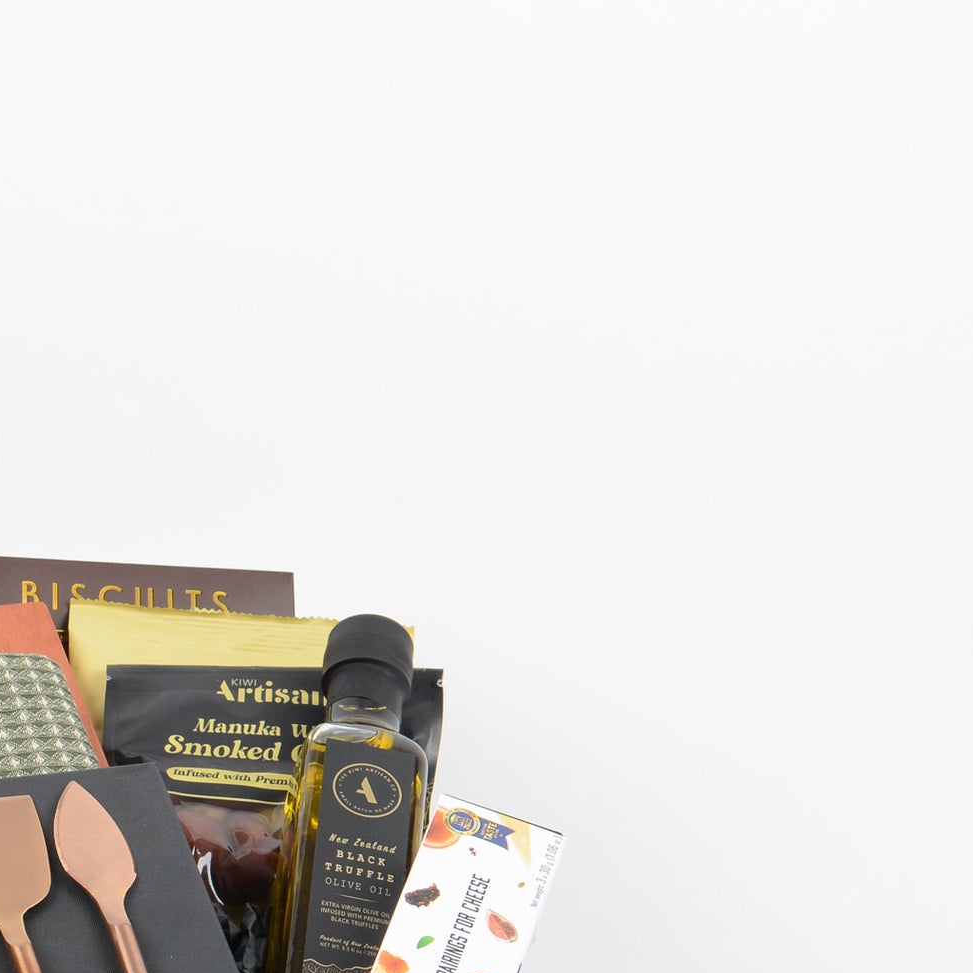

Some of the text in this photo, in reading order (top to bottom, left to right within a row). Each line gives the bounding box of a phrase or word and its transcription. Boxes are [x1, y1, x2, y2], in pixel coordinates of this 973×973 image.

[22, 580, 229, 612] BISCUITS
[216, 680, 327, 706] Artisan
[231, 678, 257, 687] KIWI
[193, 718, 281, 737] Manuka
[164, 734, 282, 762] Smoked
[173, 769, 219, 779] Infused
[223, 773, 251, 782] with
[328, 833, 397, 854] New Zealand
[336, 849, 386, 867] BLACK
[324, 861, 395, 883] TRUFFLE
[325, 876, 392, 897] OLIVE OIL
[461, 873, 491, 912] CHEESE
[320, 907, 346, 917] INFUSED
[347, 911, 362, 920] WITH
[321, 900, 340, 908] EXTRA
[341, 903, 362, 912] VIRGIN
[362, 907, 380, 917] OLIVE
[330, 916, 379, 930] BLACK TRUFFLES
[453, 912, 476, 935] FOR
